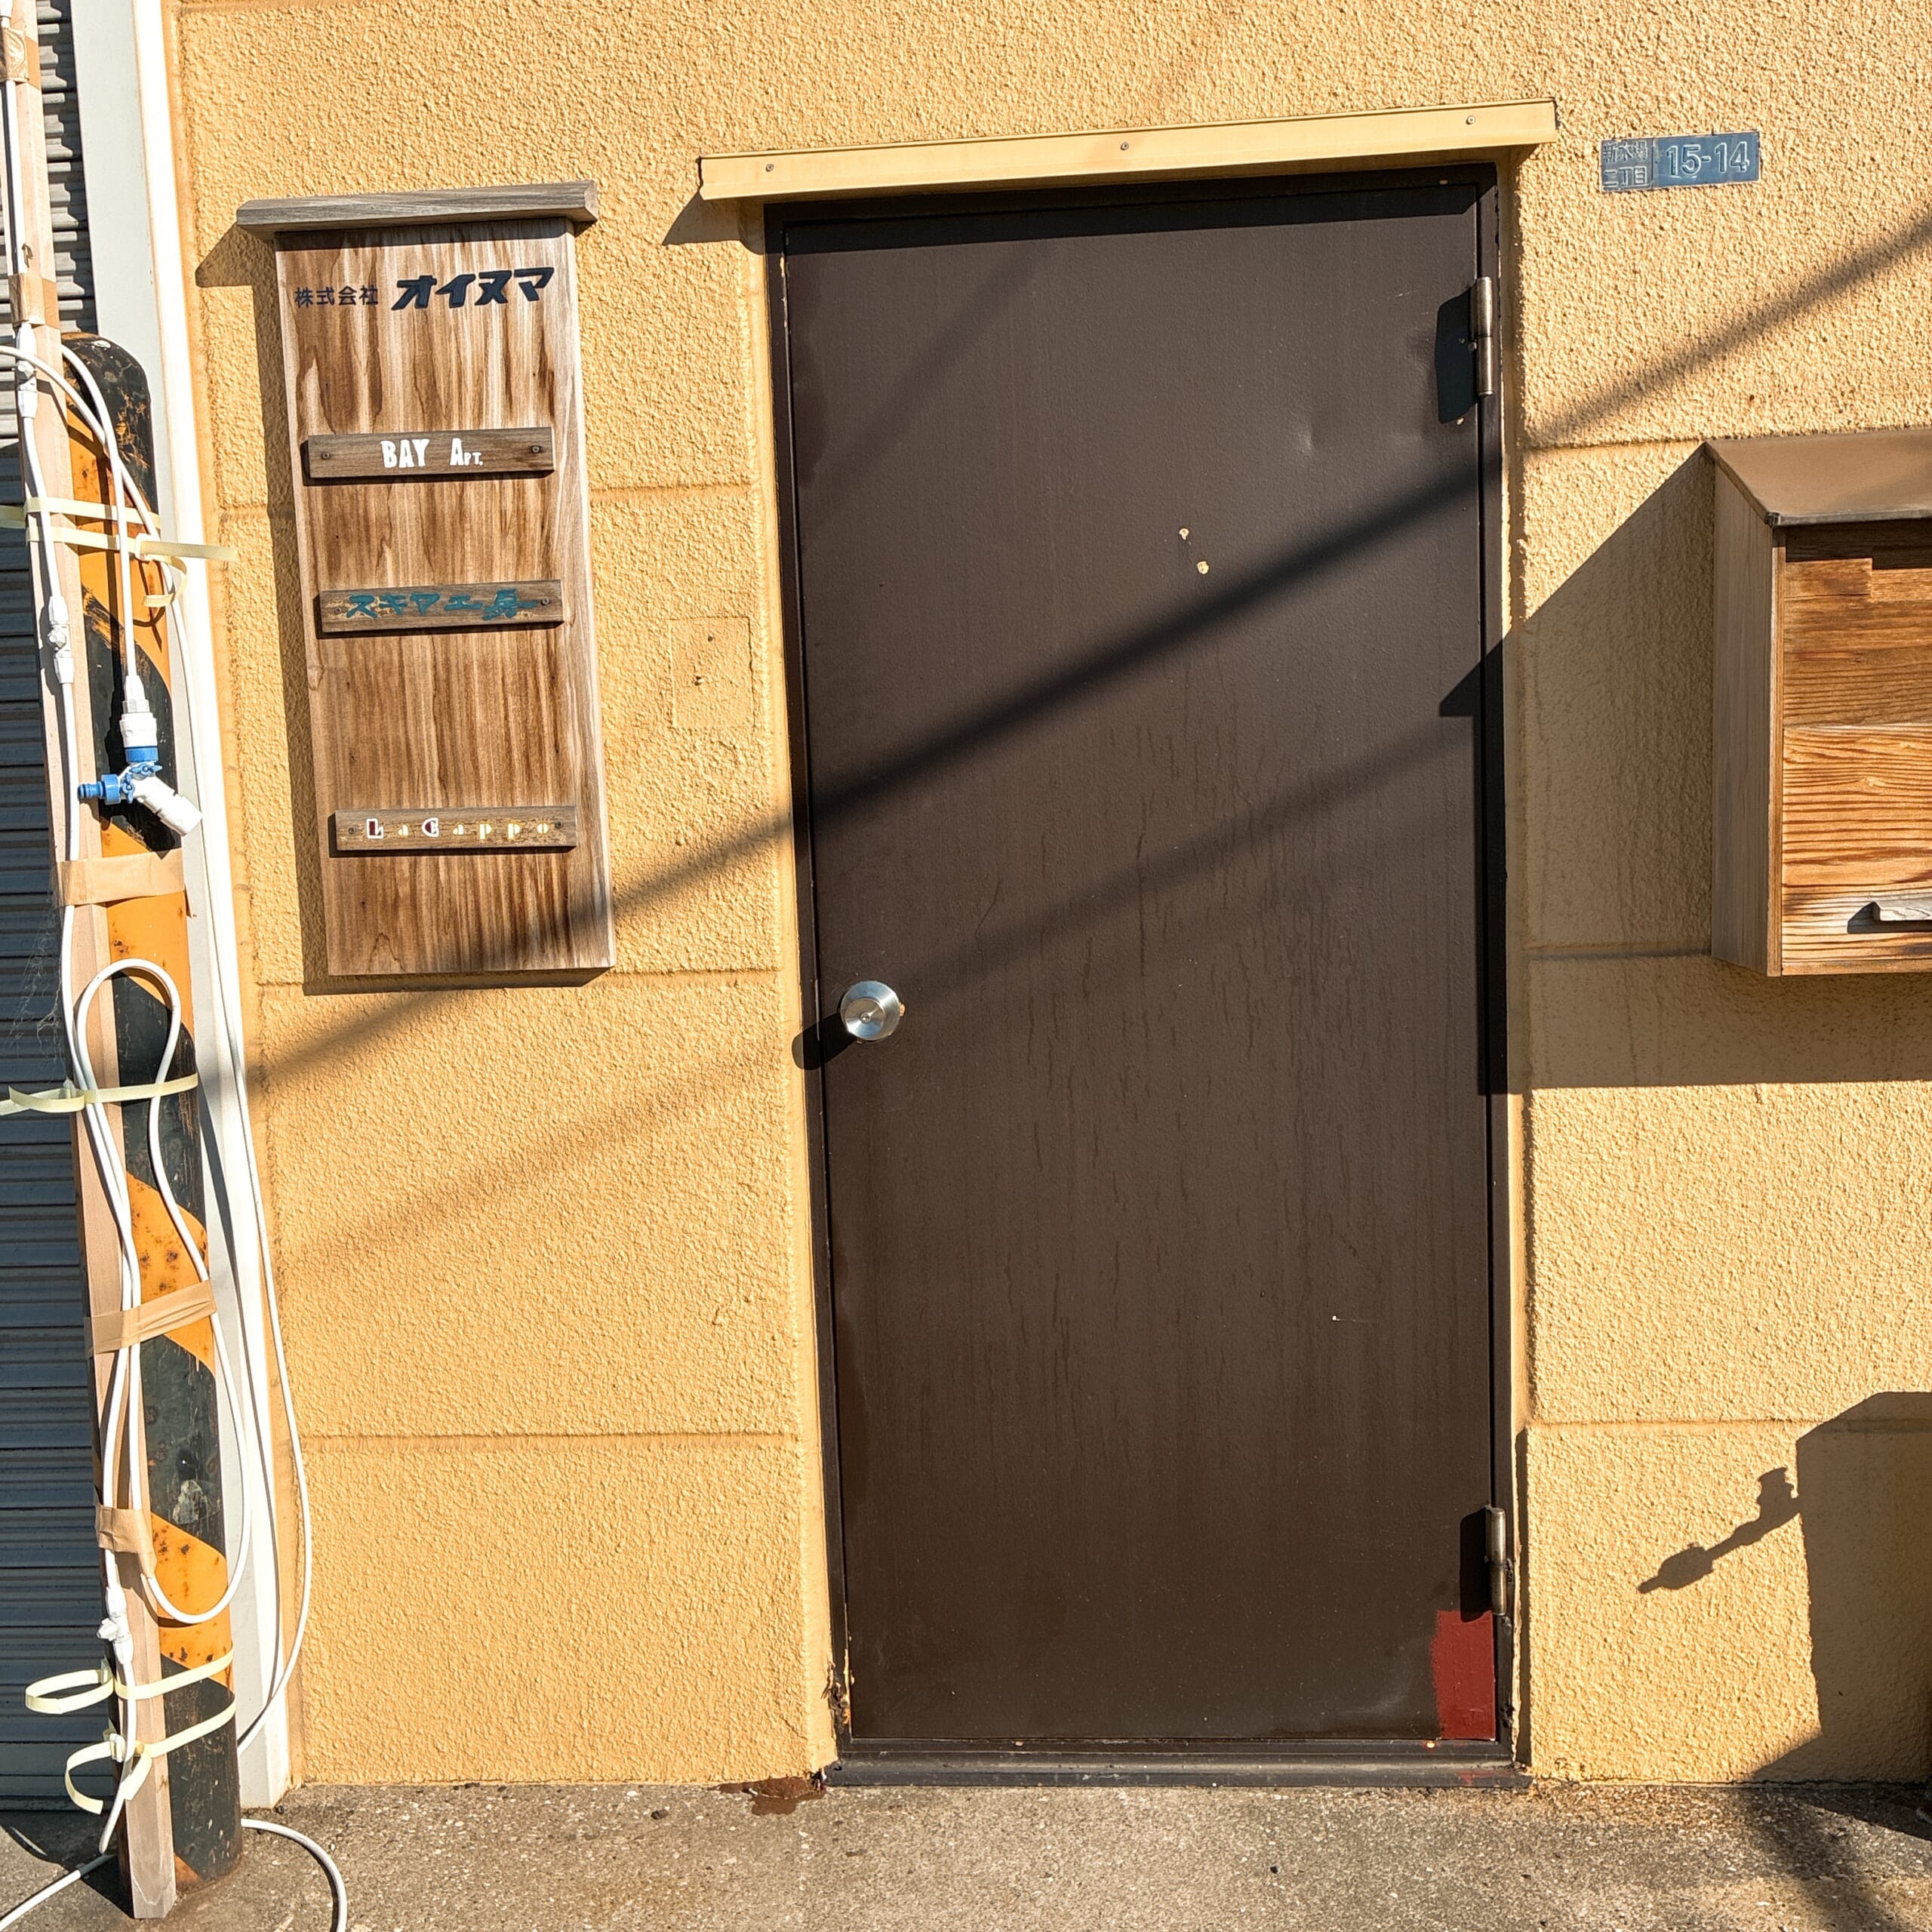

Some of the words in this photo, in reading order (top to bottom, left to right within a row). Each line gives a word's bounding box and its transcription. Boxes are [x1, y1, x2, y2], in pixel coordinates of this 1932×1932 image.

[1603, 140, 1648, 163] 新木場
[1666, 140, 1749, 176] 15-14
[1604, 165, 1650, 188] 二丁目
[294, 285, 378, 309] 株式会社
[391, 267, 555, 311] オイヌマ
[380, 438, 430, 469] BAY
